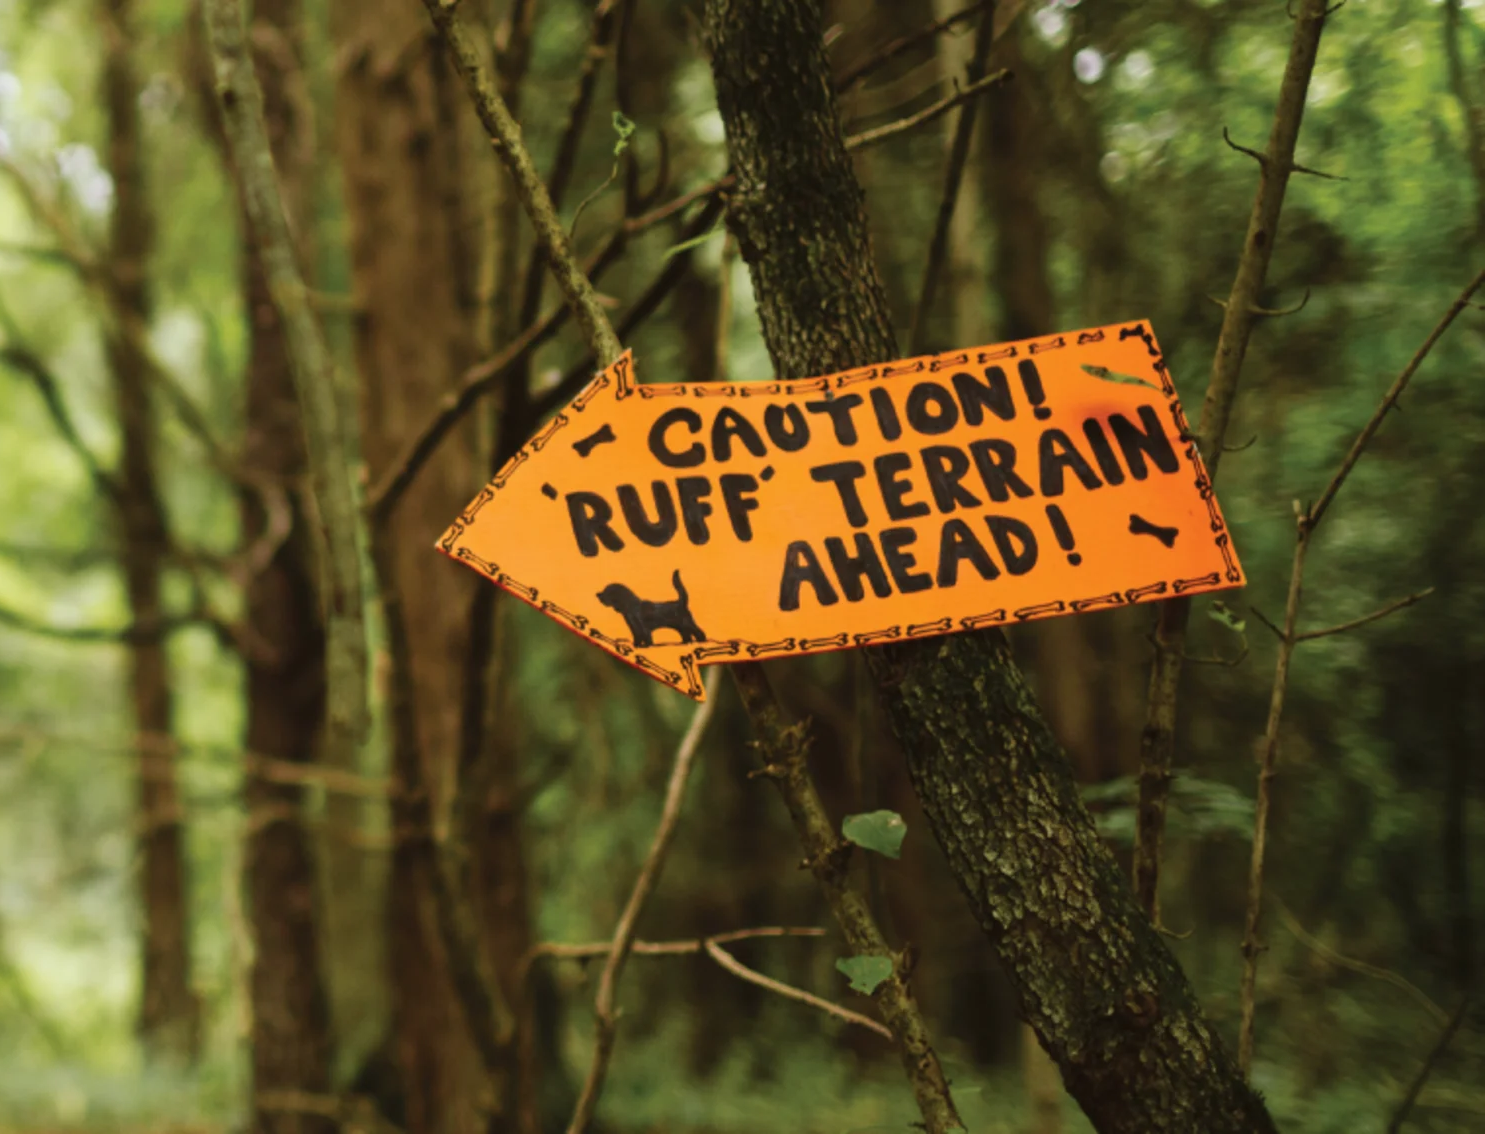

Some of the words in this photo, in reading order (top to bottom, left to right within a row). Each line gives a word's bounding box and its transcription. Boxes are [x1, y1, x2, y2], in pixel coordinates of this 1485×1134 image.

[648, 359, 1051, 468] CAUTION!
[809, 403, 1181, 529] TERRAIN
[778, 505, 1082, 611] AHEAD!
